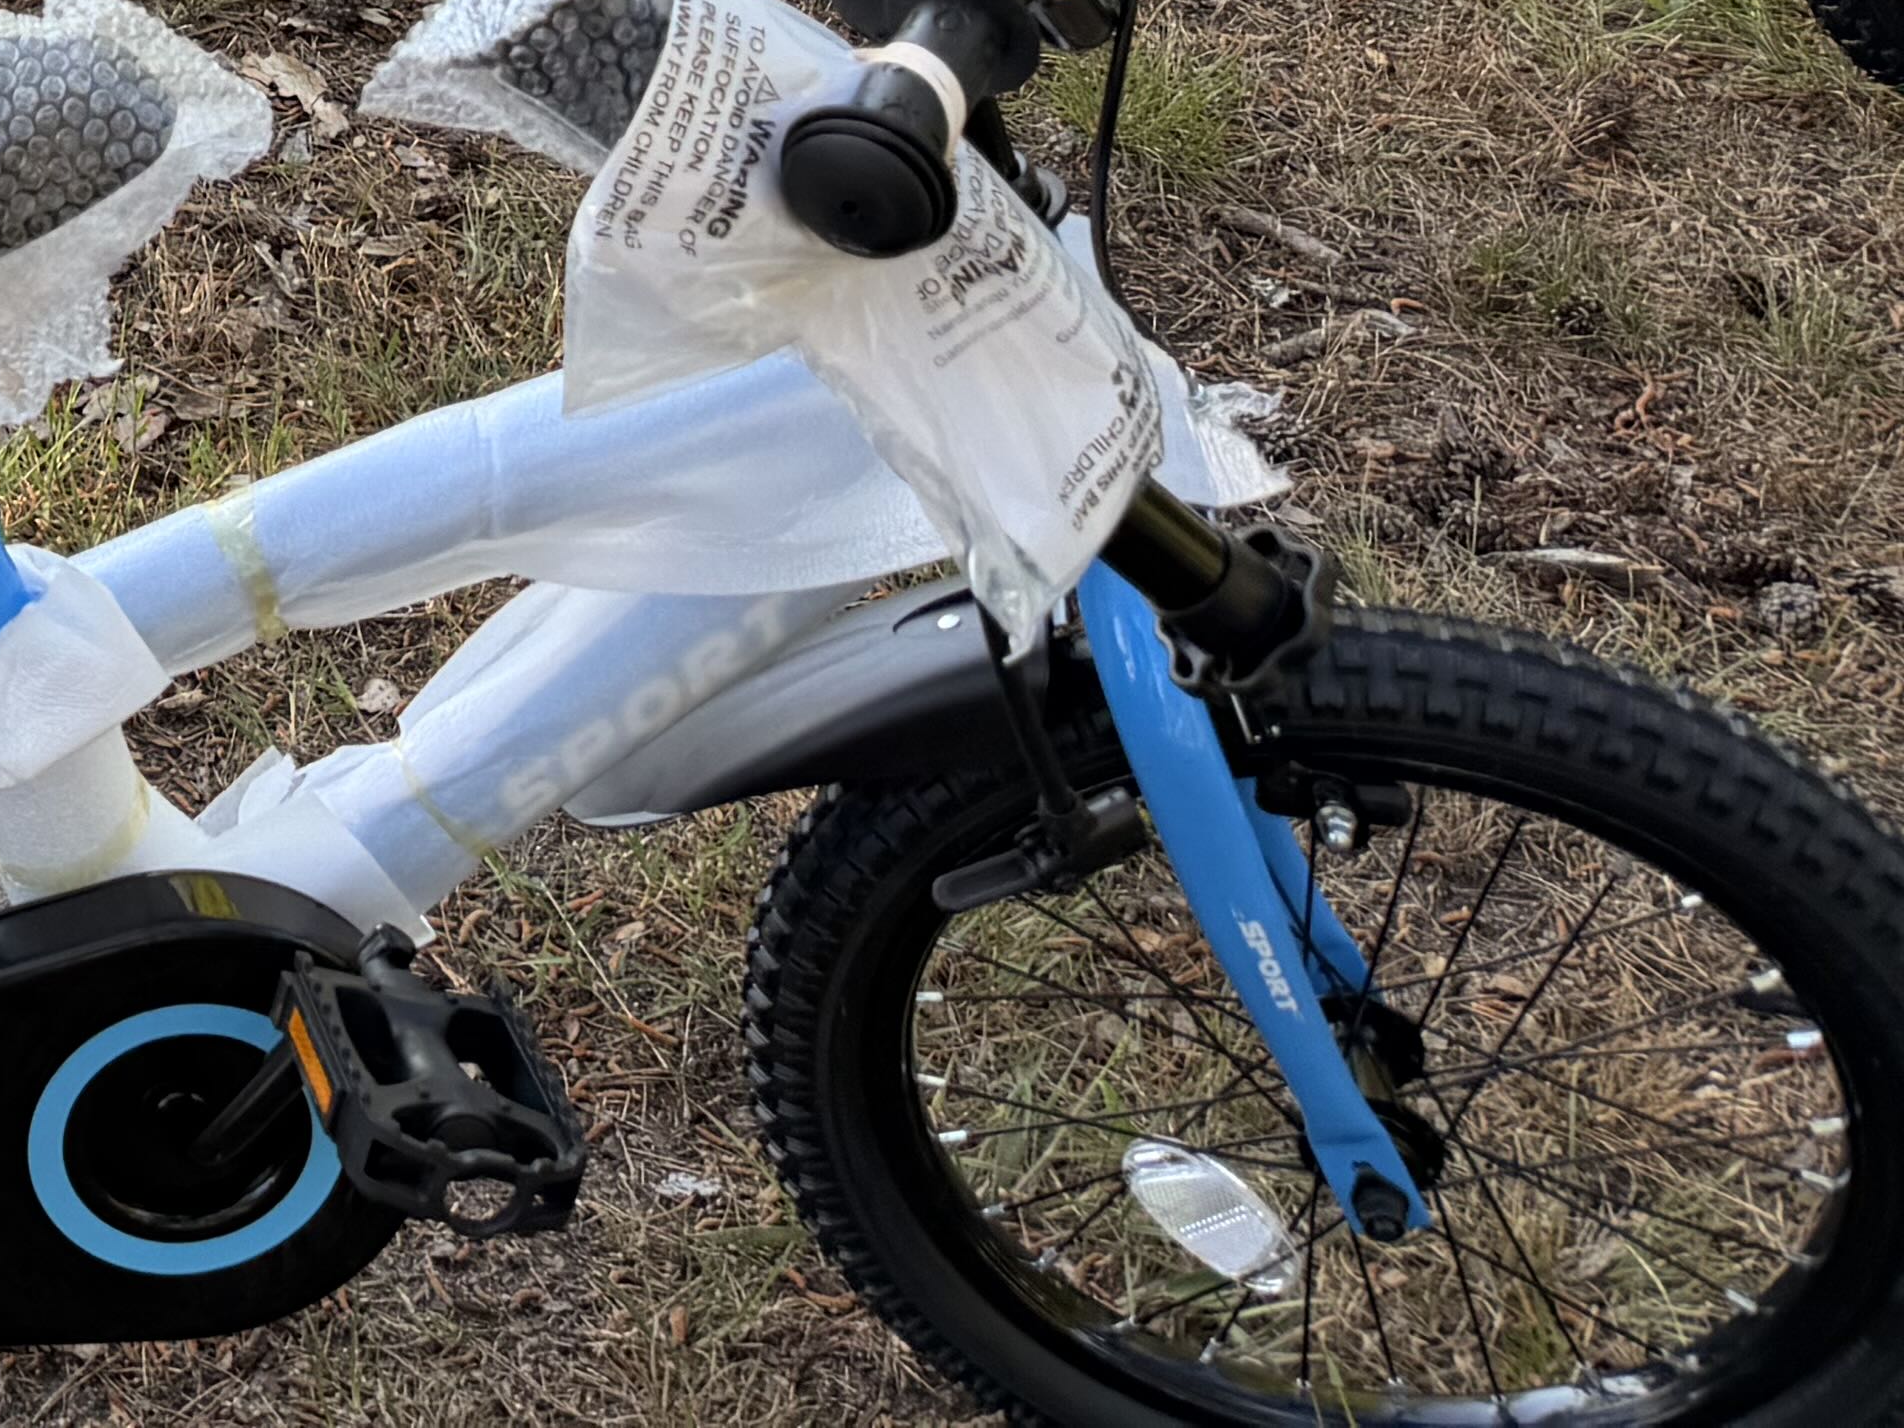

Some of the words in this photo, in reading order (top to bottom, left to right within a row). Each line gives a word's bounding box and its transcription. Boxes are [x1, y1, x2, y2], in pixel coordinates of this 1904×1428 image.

[686, 0, 717, 90] PLEASE
[749, 23, 766, 56] TO
[645, 59, 681, 129] FROM
[667, 92, 699, 154] KEEP
[728, 55, 760, 129] AVOID
[595, 131, 653, 239] CHILDREN
[641, 160, 675, 207] THIS
[686, 134, 740, 225] DANGER
[624, 208, 646, 250] BAG
[678, 229, 697, 258] OF
[1237, 919, 1300, 1016] SPORT
